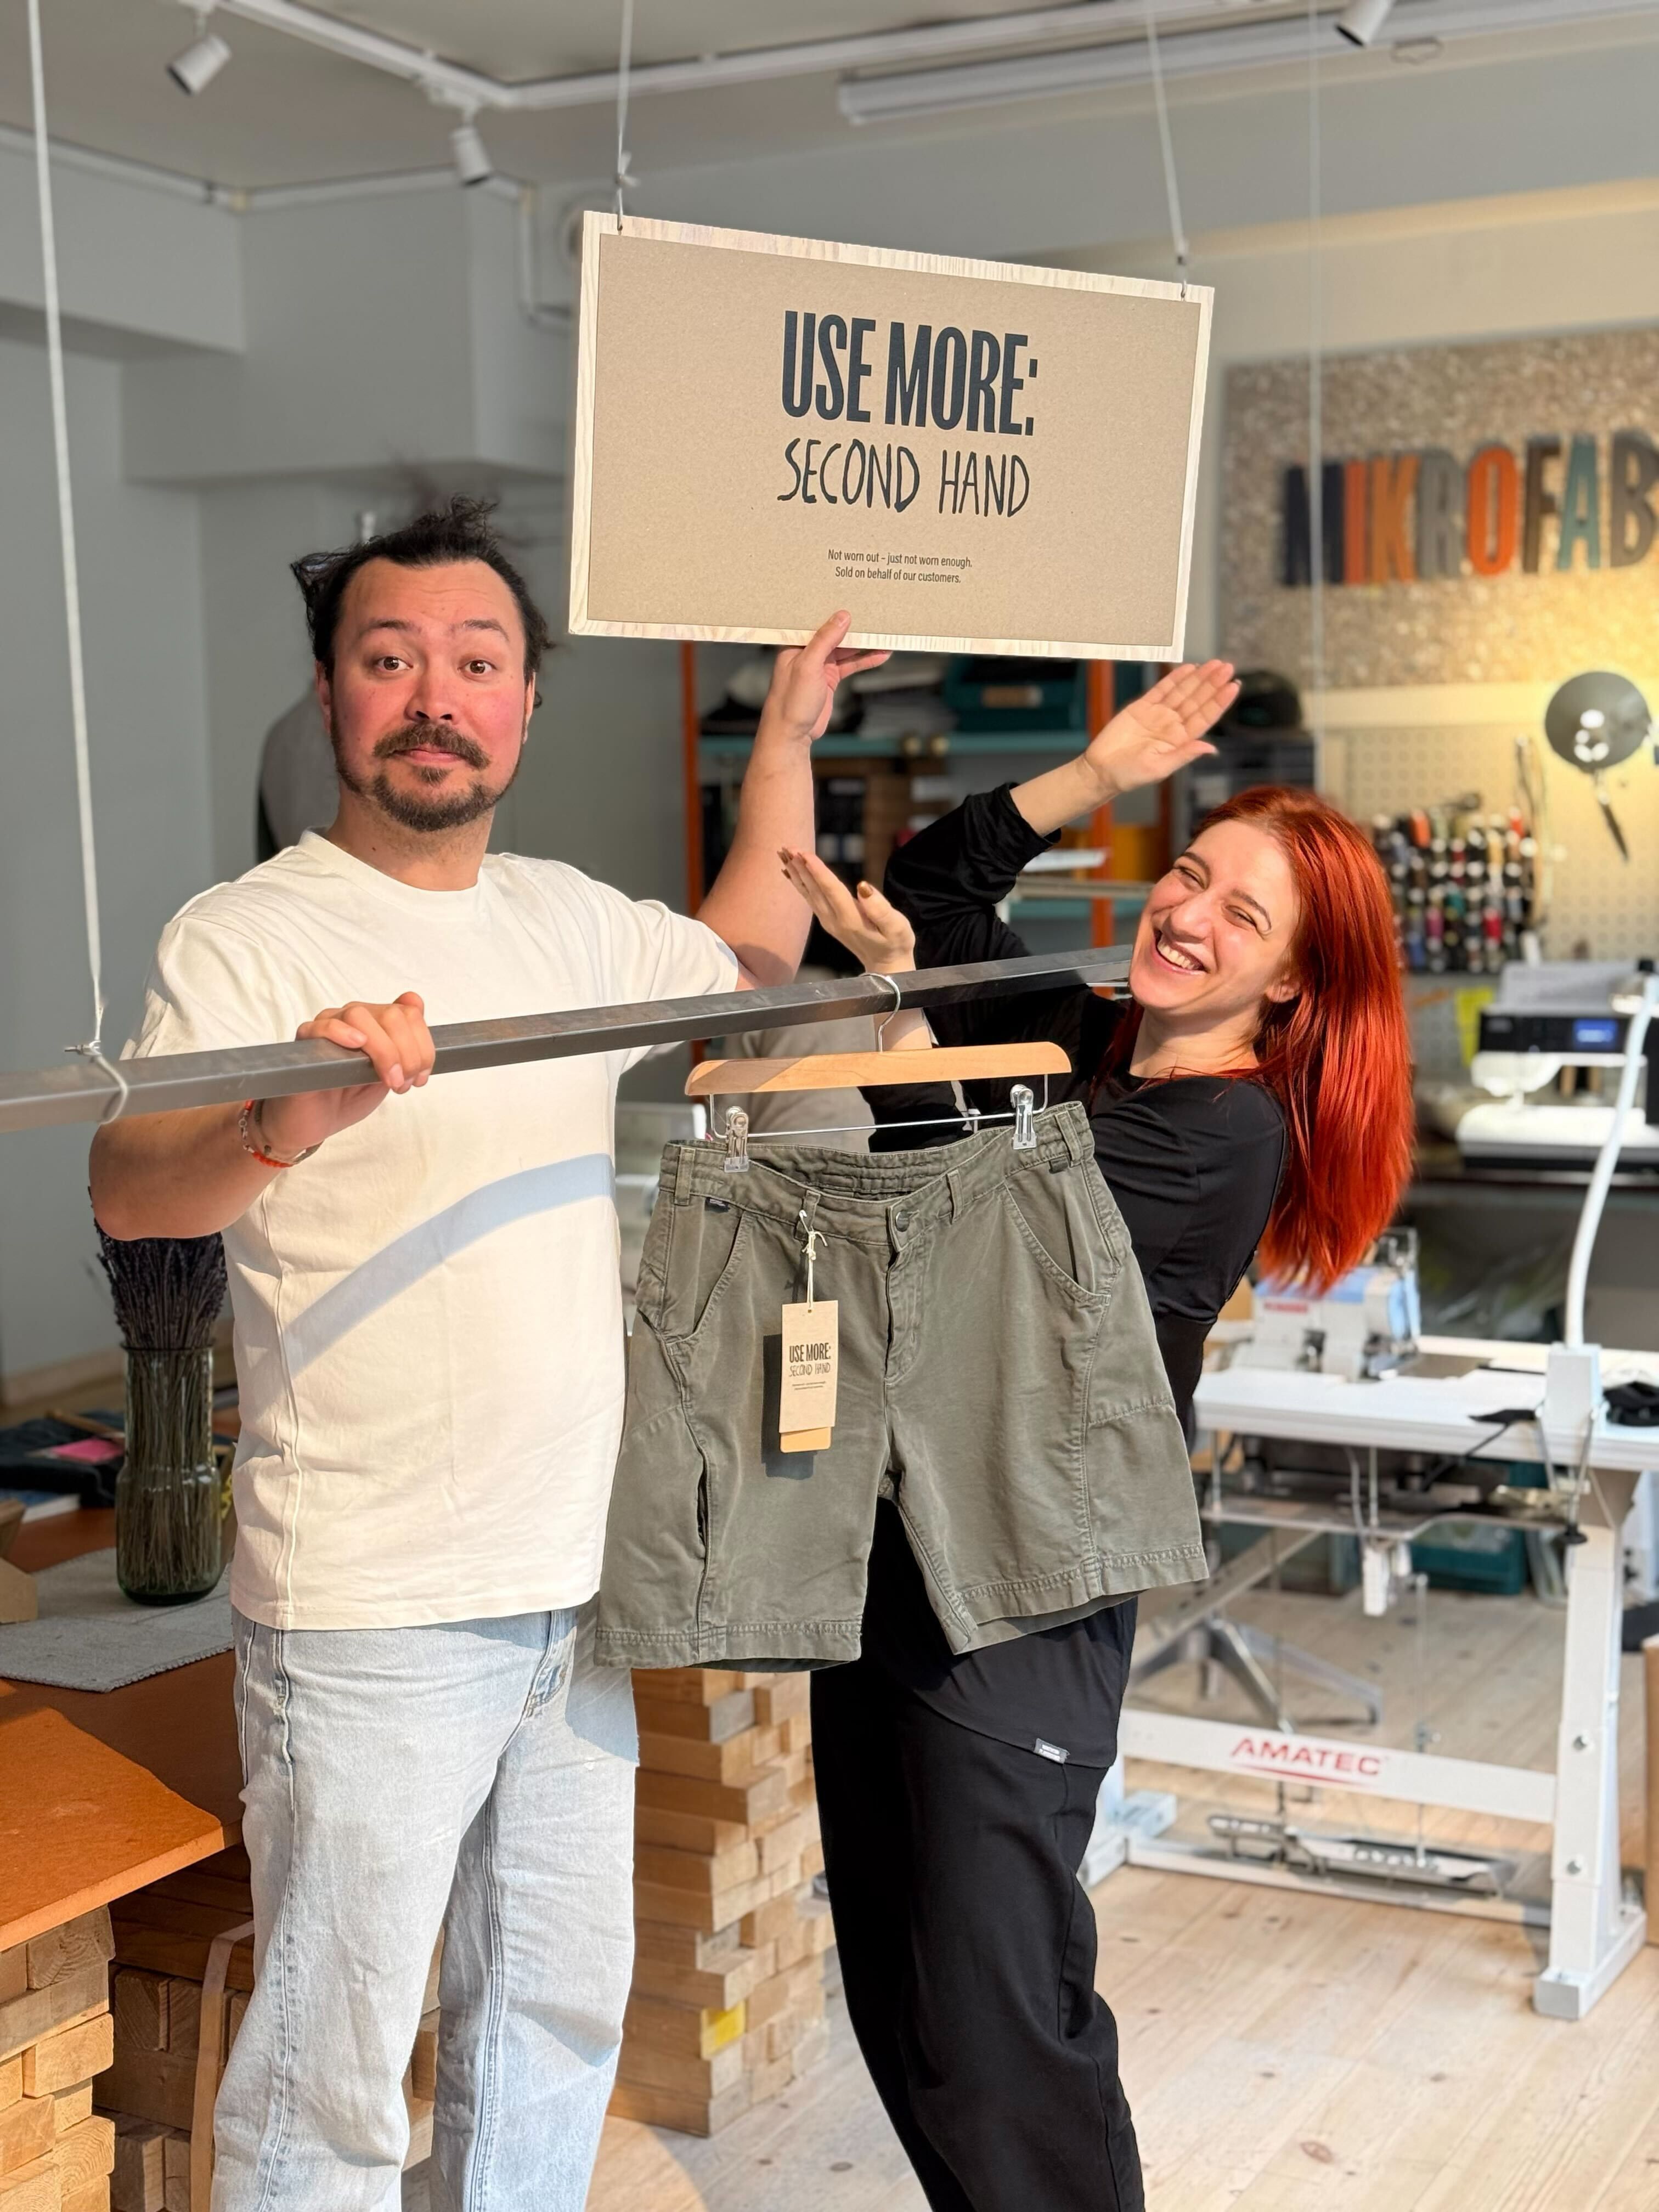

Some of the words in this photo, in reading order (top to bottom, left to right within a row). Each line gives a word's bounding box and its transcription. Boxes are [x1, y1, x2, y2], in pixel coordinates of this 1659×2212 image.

[782, 310, 876, 423] USE
[884, 321, 1039, 436] MORE:
[776, 437, 920, 513] SECOND
[939, 449, 1029, 517] HAND
[828, 549, 842, 560] Not
[844, 552, 864, 561] worn
[866, 553, 879, 562] out
[887, 552, 902, 566] just
[904, 555, 917, 565] not
[919, 557, 939, 566] worn
[941, 556, 973, 569] enough.
[835, 566, 853, 578] Sold
[855, 569, 865, 578] on
[867, 567, 893, 580] behalf
[893, 569, 902, 580] of
[902, 572, 916, 580] our
[918, 572, 961, 583] customers.
[789, 1345, 804, 1363] USE
[806, 1342, 831, 1362] MORE:
[789, 1364, 812, 1377] SECOND
[815, 1362, 831, 1375] HAND
[1232, 1737, 1380, 1776] AMATEC
